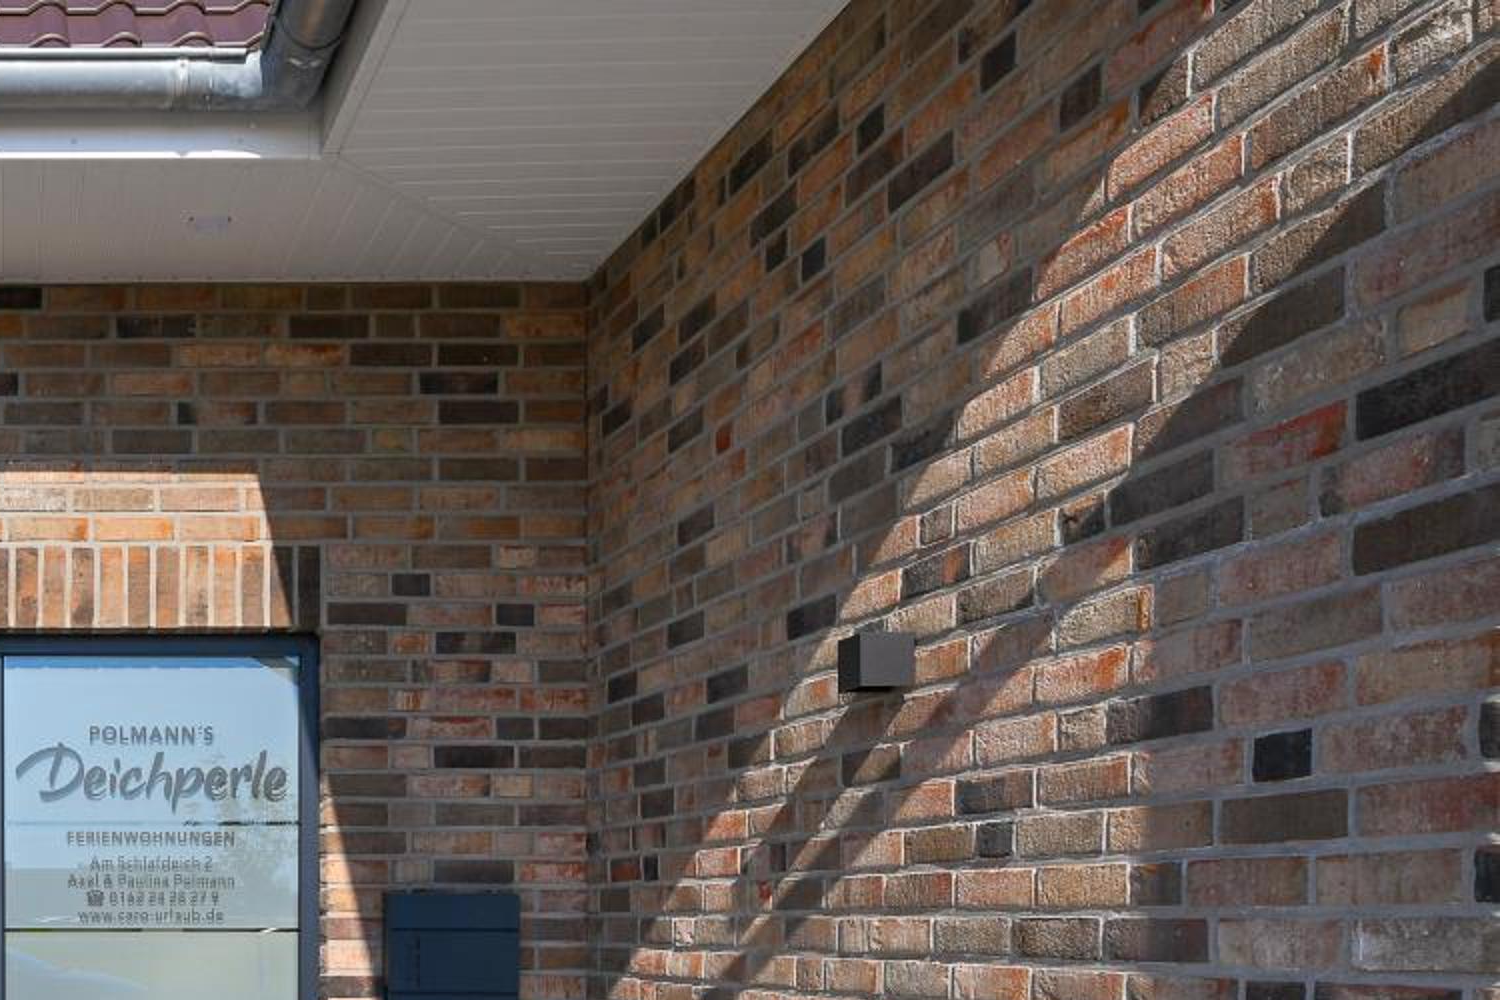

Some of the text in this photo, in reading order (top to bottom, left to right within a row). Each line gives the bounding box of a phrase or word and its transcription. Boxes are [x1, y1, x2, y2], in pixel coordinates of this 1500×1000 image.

[16, 742, 287, 815] Deichperle
[67, 831, 235, 847] FERIENWOHNUNGEN
[90, 856, 113, 872] Am
[204, 856, 213, 872] 2
[67, 873, 99, 889] Axel
[103, 874, 113, 889] &
[173, 873, 235, 889] Polmann
